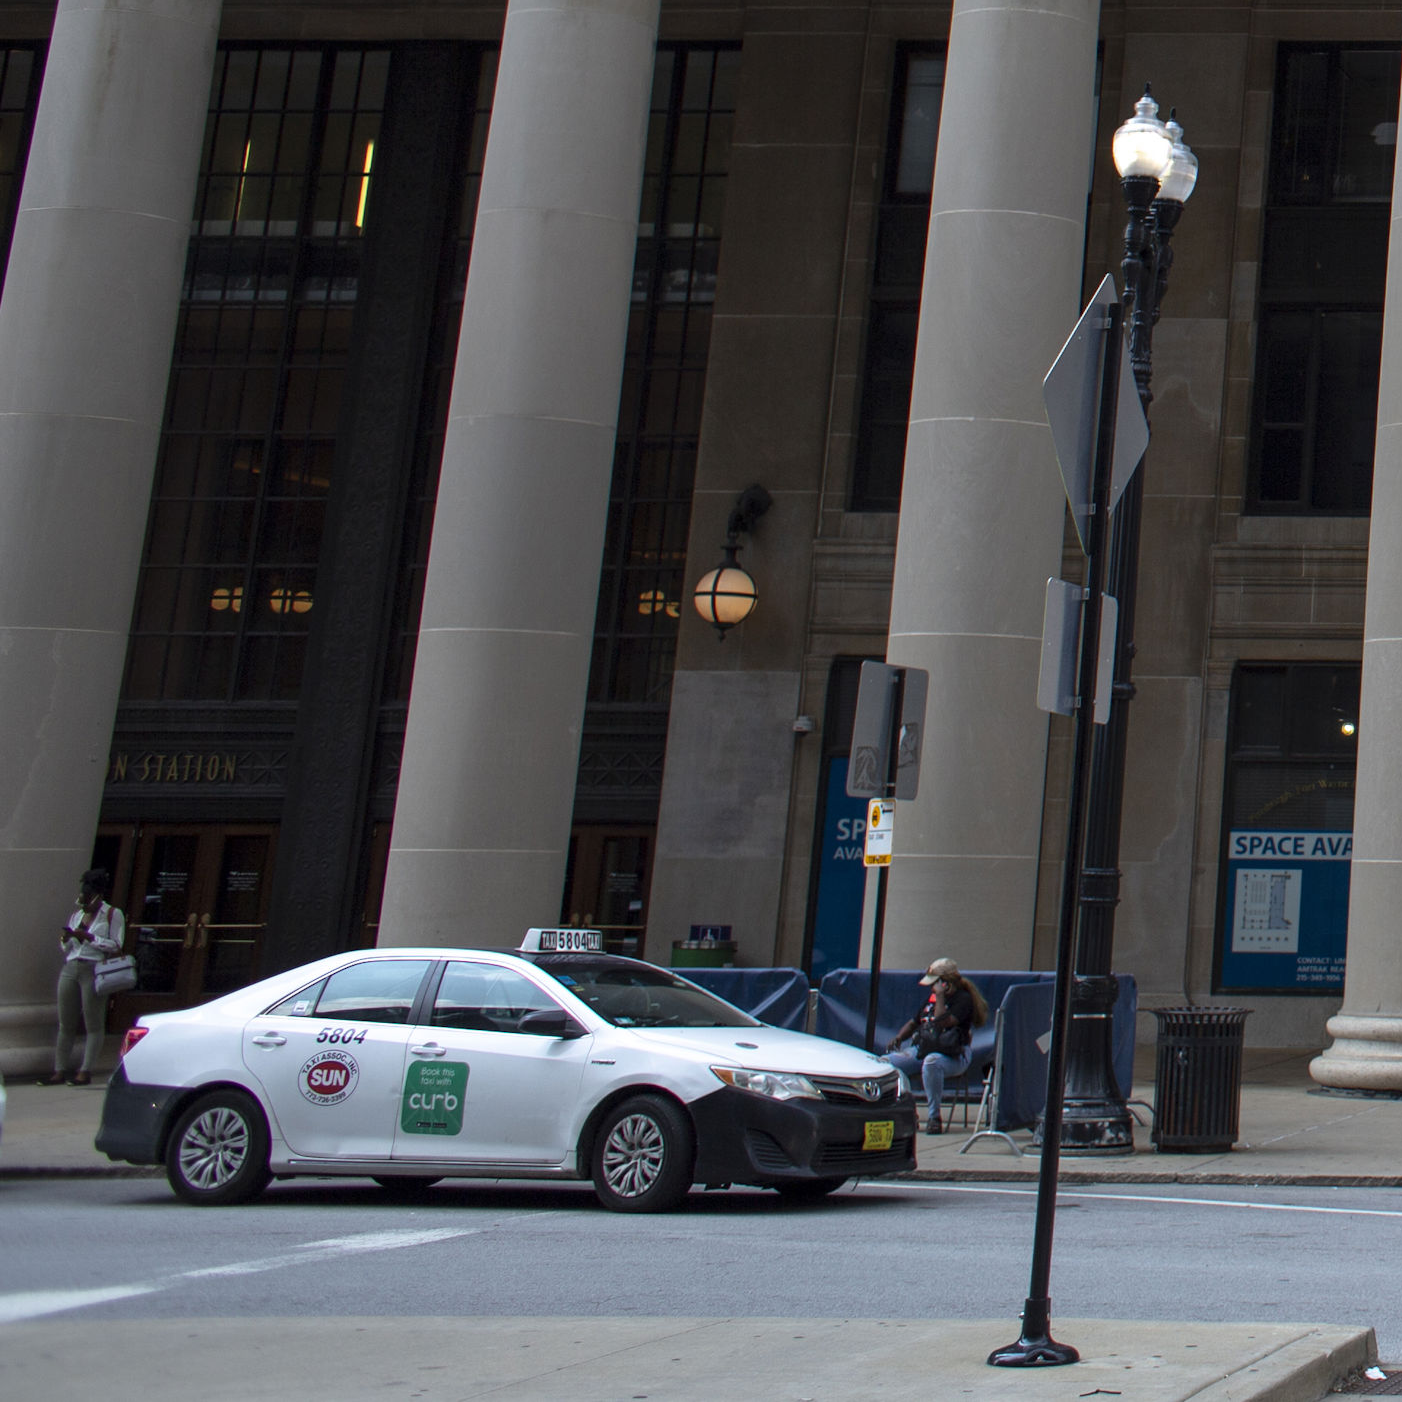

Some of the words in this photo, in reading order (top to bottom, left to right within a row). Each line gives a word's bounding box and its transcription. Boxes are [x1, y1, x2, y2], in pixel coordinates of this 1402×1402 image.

[140, 754, 237, 781] STATION
[1235, 836, 1304, 855] SPACE
[559, 931, 587, 950] 5804
[316, 1027, 369, 1045] 5804
[302, 1056, 320, 1074] TAXI
[310, 1068, 347, 1087] SUN
[409, 1091, 458, 1111] curb
